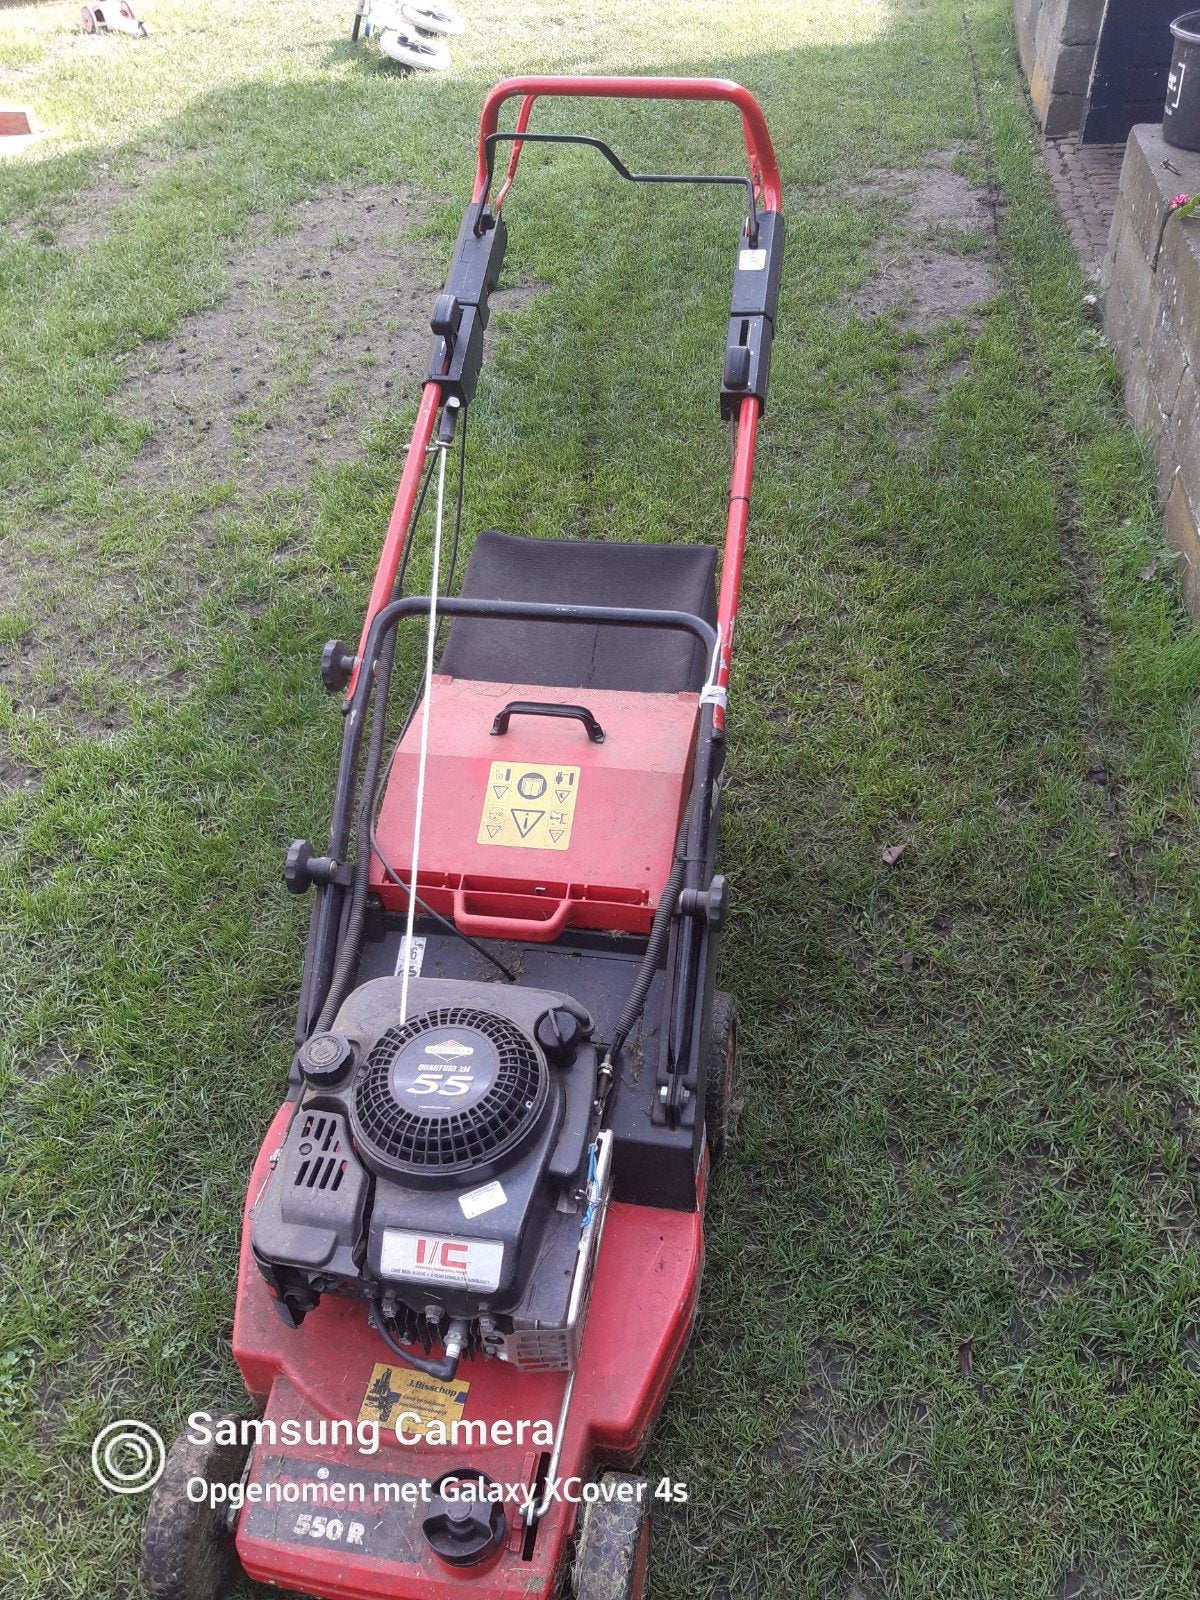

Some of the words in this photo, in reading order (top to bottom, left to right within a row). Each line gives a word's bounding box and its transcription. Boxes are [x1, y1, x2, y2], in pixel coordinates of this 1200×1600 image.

[417, 1063, 458, 1073] QUANTUM
[406, 1073, 474, 1096] 55
[416, 1239, 468, 1269] I/C
[293, 1513, 344, 1542] 550
[346, 1521, 366, 1546] R
